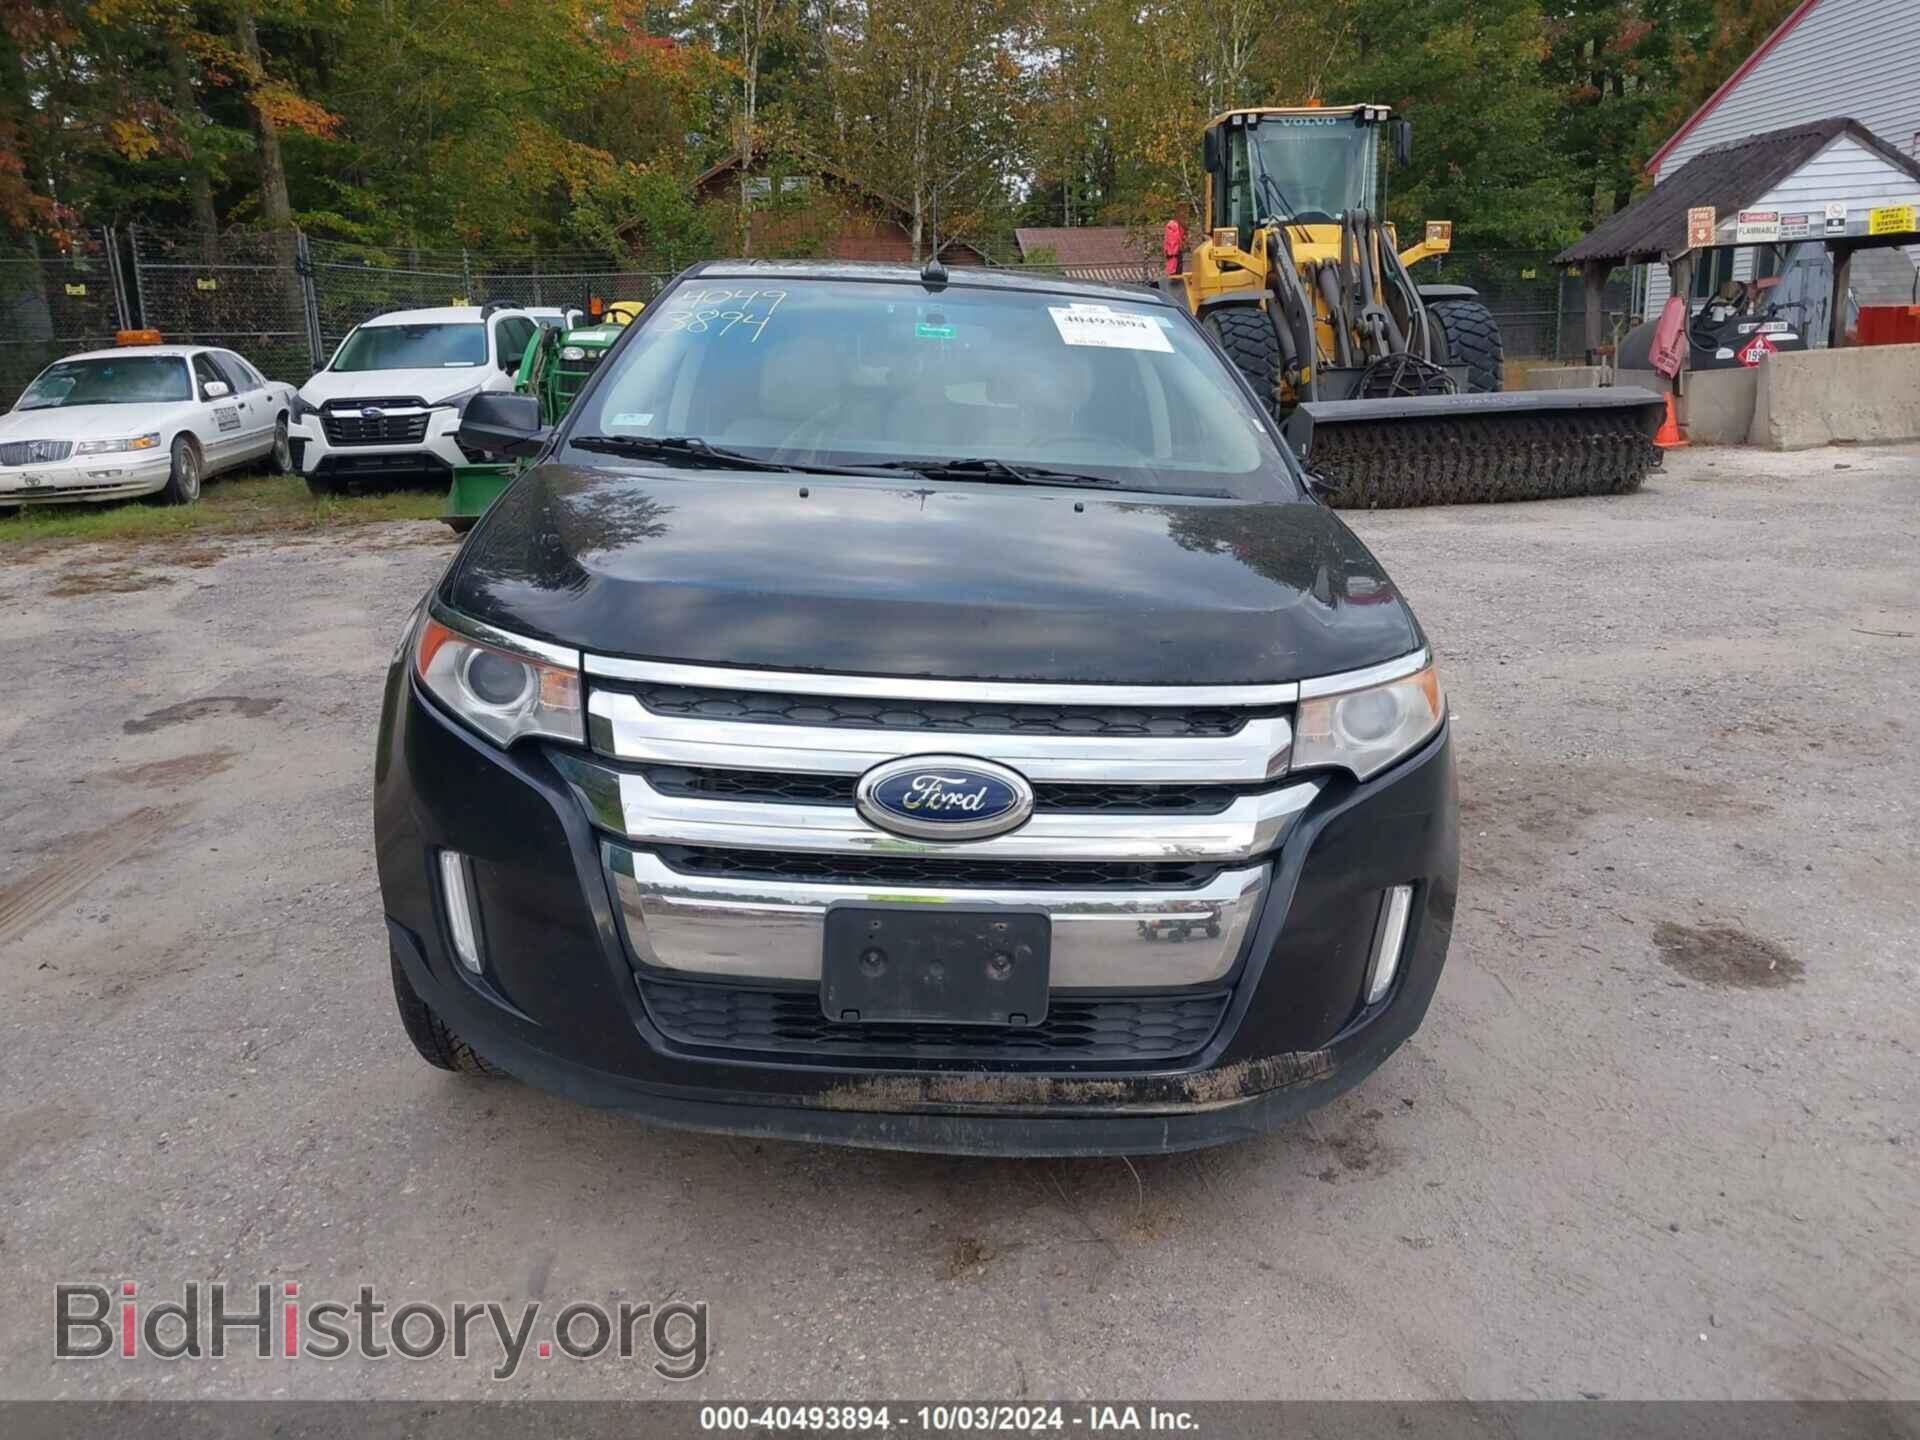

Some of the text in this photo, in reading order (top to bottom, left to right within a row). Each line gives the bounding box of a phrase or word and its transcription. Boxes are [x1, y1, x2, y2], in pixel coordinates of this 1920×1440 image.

[1280, 117, 1336, 127] VOLVO
[1739, 224, 1778, 234] FLAMMABLE
[681, 289, 787, 315] 4049
[656, 309, 770, 343] 3894
[903, 774, 988, 811] Ford
